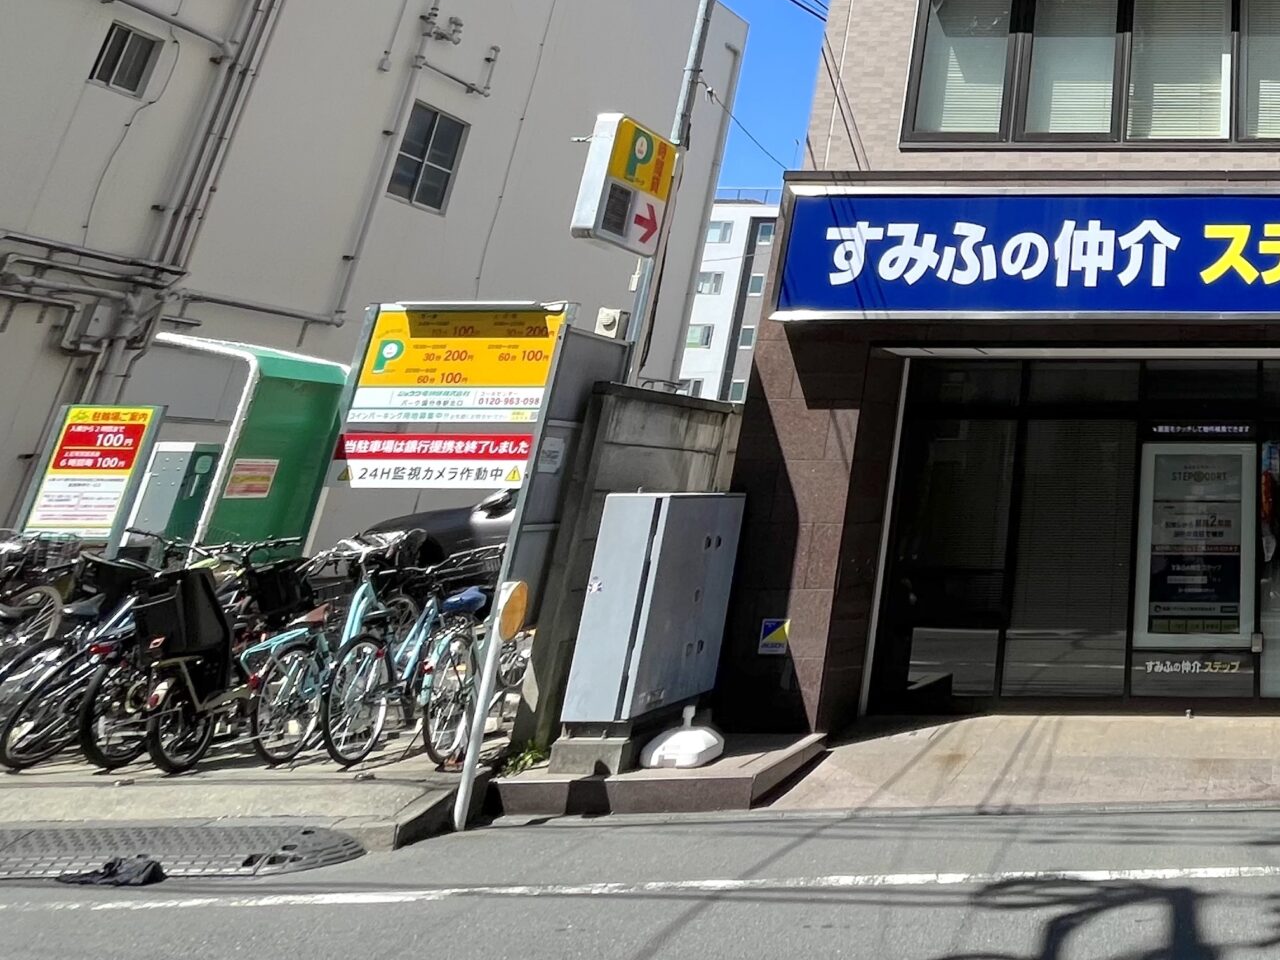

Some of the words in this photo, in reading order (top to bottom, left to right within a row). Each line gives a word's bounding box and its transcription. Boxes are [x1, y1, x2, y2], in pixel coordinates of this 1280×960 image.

[826, 219, 1181, 288] すみふの仲介
[96, 433, 134, 447] 100円
[358, 466, 504, 481] 24H監視カメラ作動中
[1145, 660, 1202, 674] すみふの仲介
[1203, 660, 1241, 673] ステップ
